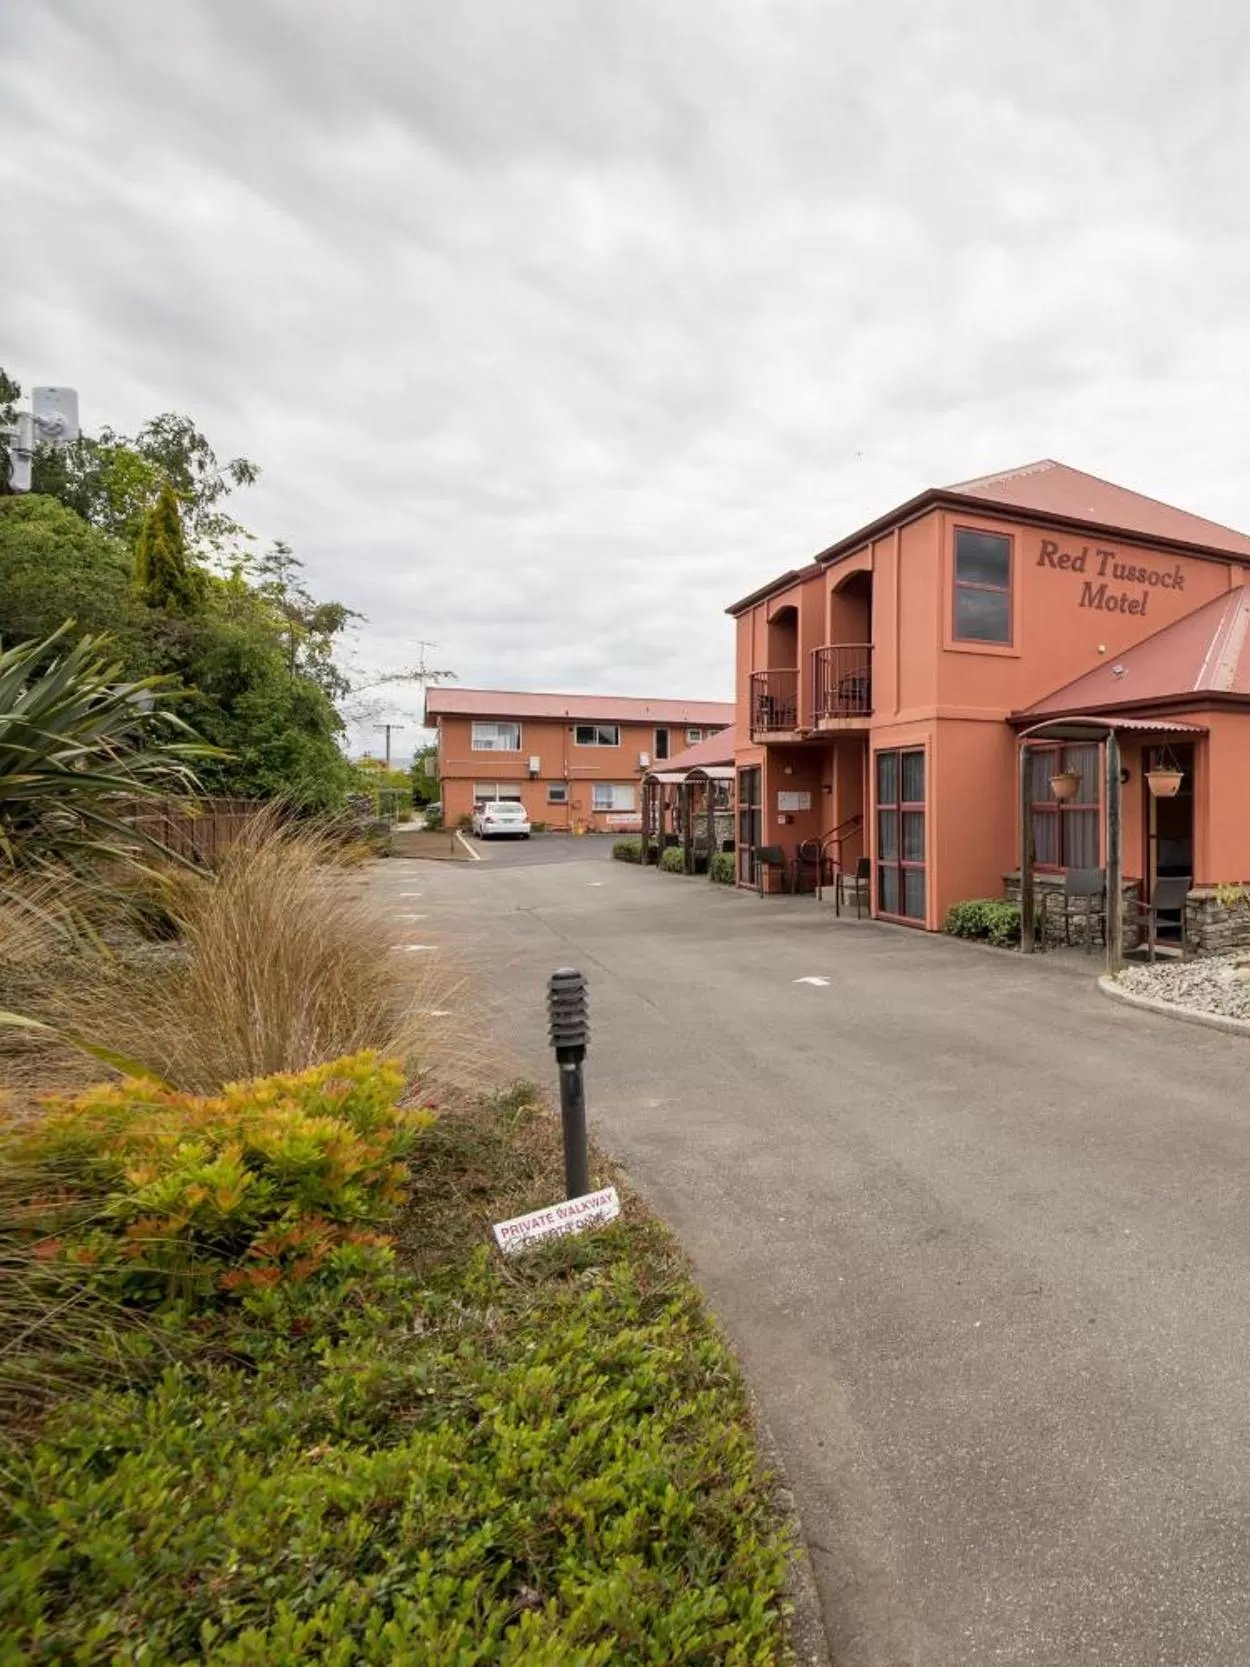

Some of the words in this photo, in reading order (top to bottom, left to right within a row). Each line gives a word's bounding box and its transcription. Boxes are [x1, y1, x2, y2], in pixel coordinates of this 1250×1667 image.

[1036, 539, 1088, 574] Red
[1096, 549, 1186, 590] Tussock
[1078, 581, 1149, 616] Motel
[501, 1212, 556, 1238] PRIVATE
[556, 1193, 613, 1218] WALKWAY
